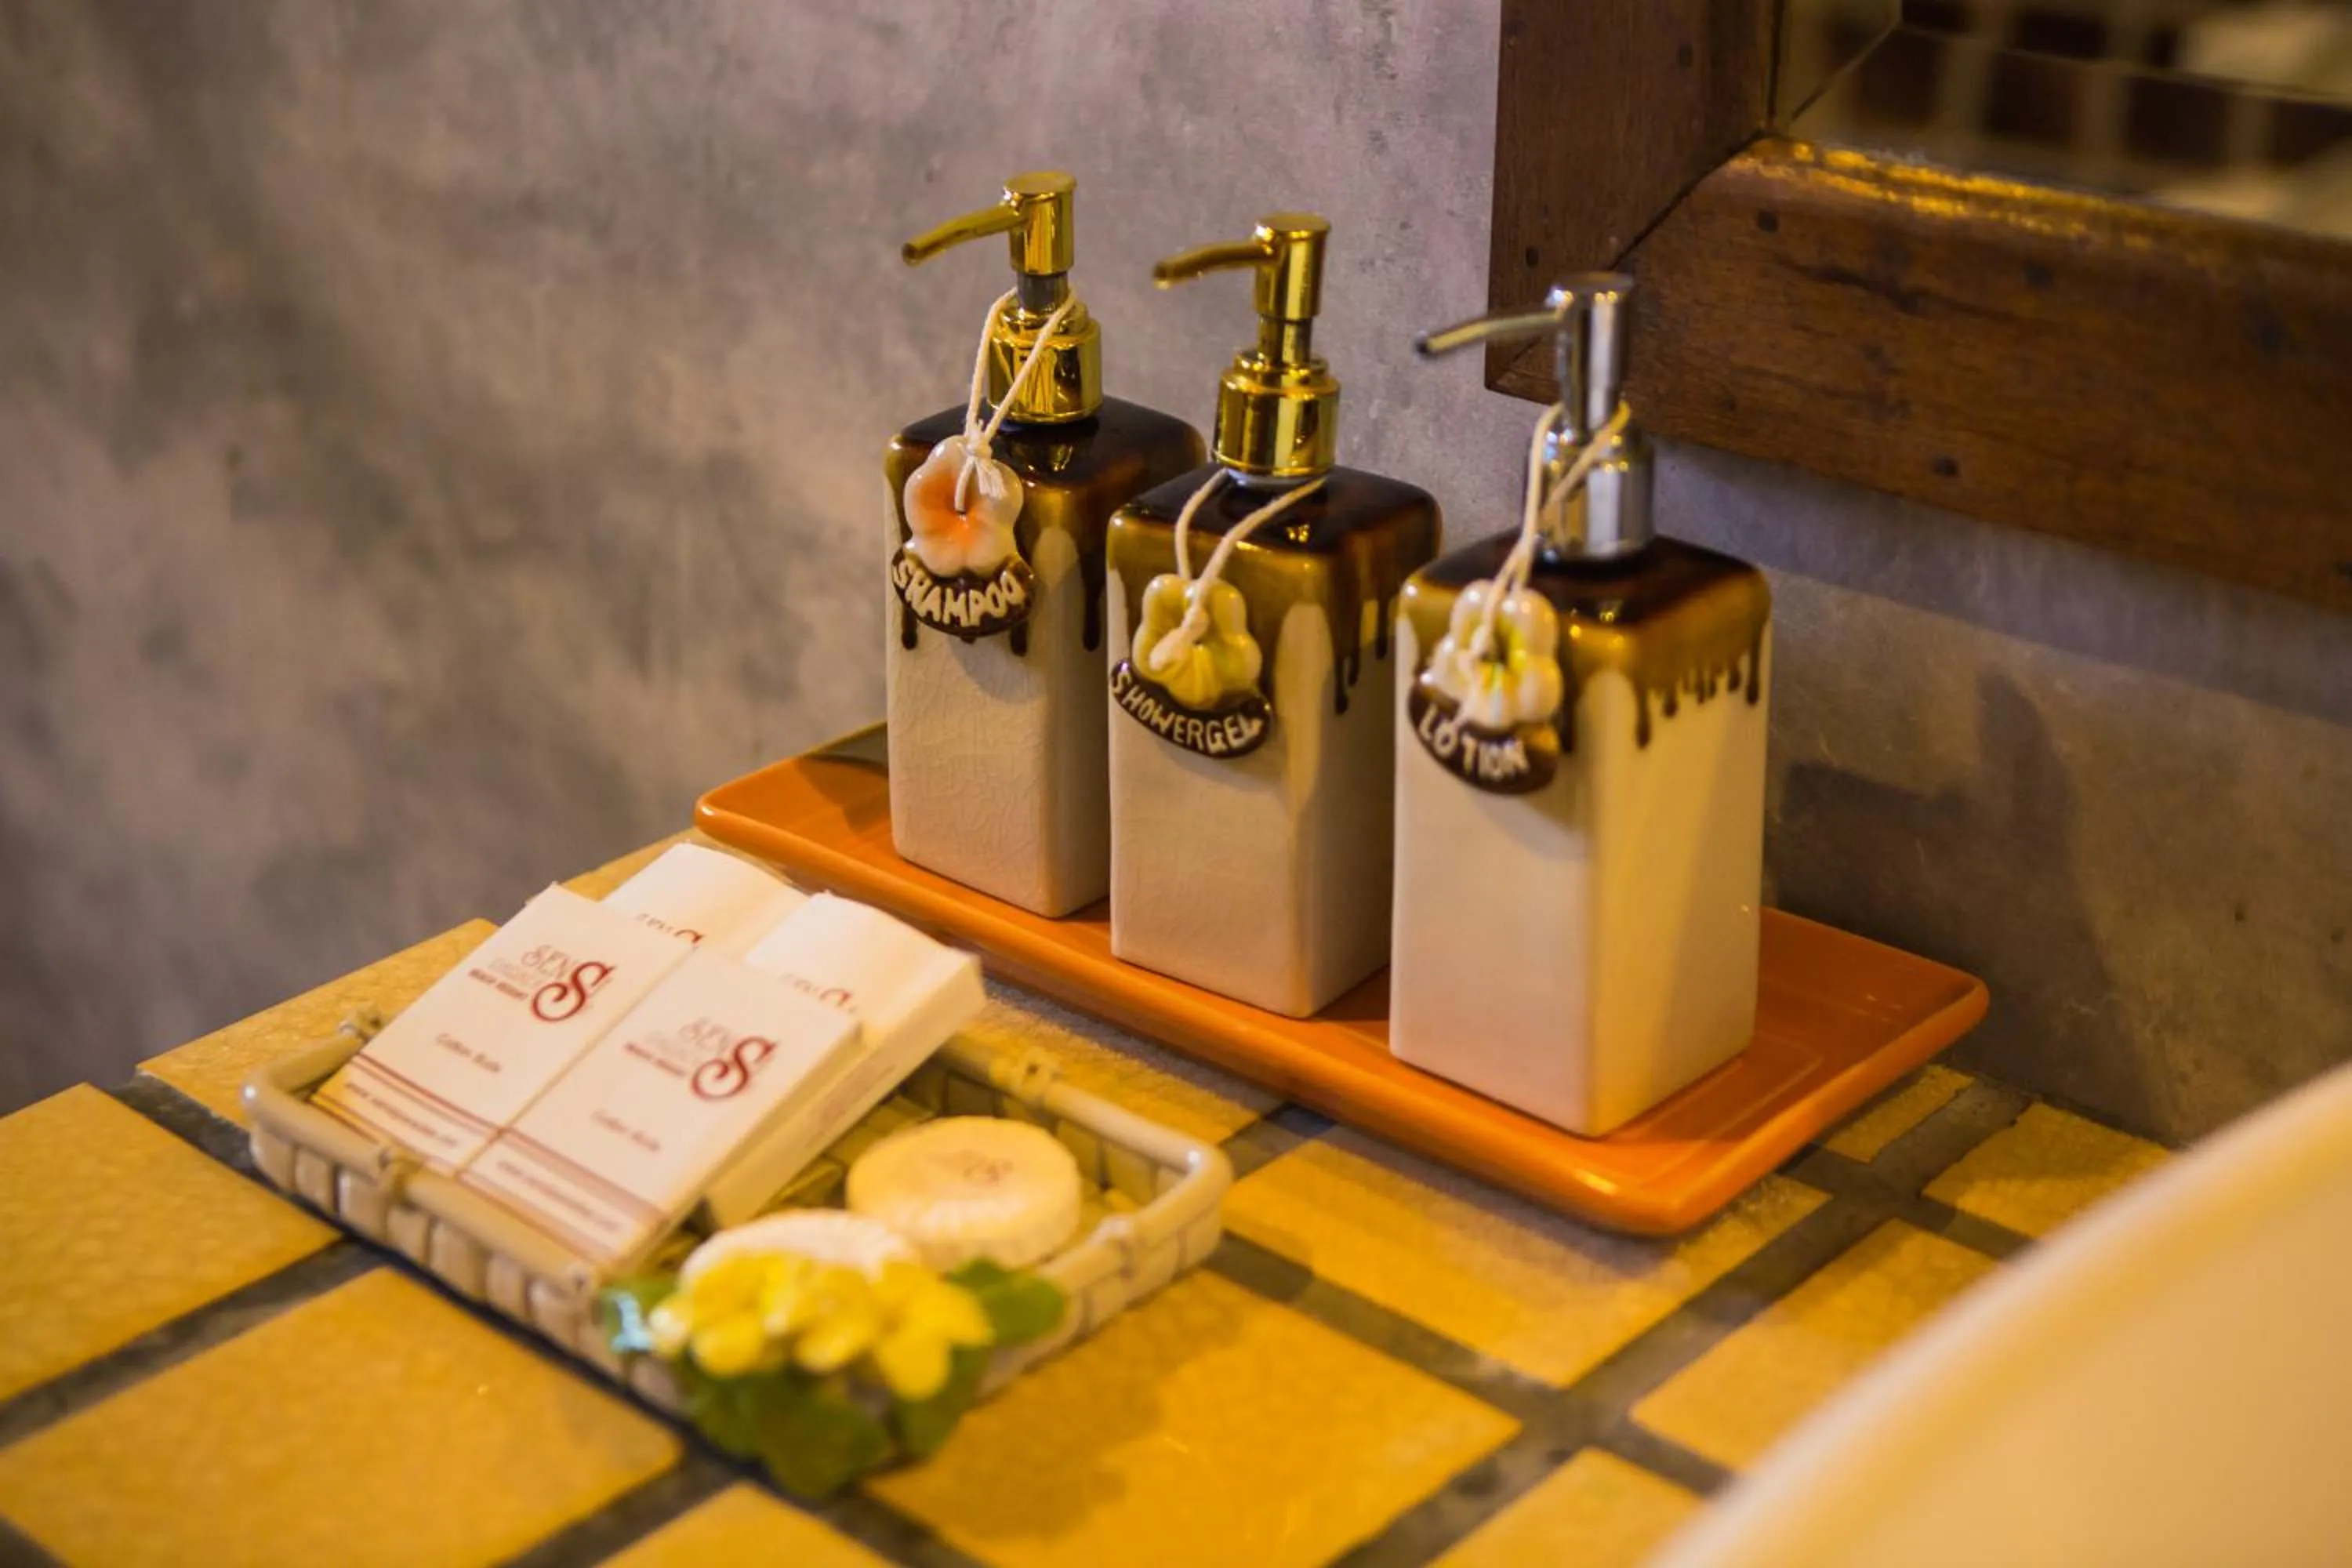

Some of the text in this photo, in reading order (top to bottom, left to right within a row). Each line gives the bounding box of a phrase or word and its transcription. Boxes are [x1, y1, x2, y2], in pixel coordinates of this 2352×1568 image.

[892, 559, 1025, 628] SHAMPOO
[1112, 670, 1263, 753] SHOWERGEL
[1419, 703, 1530, 782] LOTION
